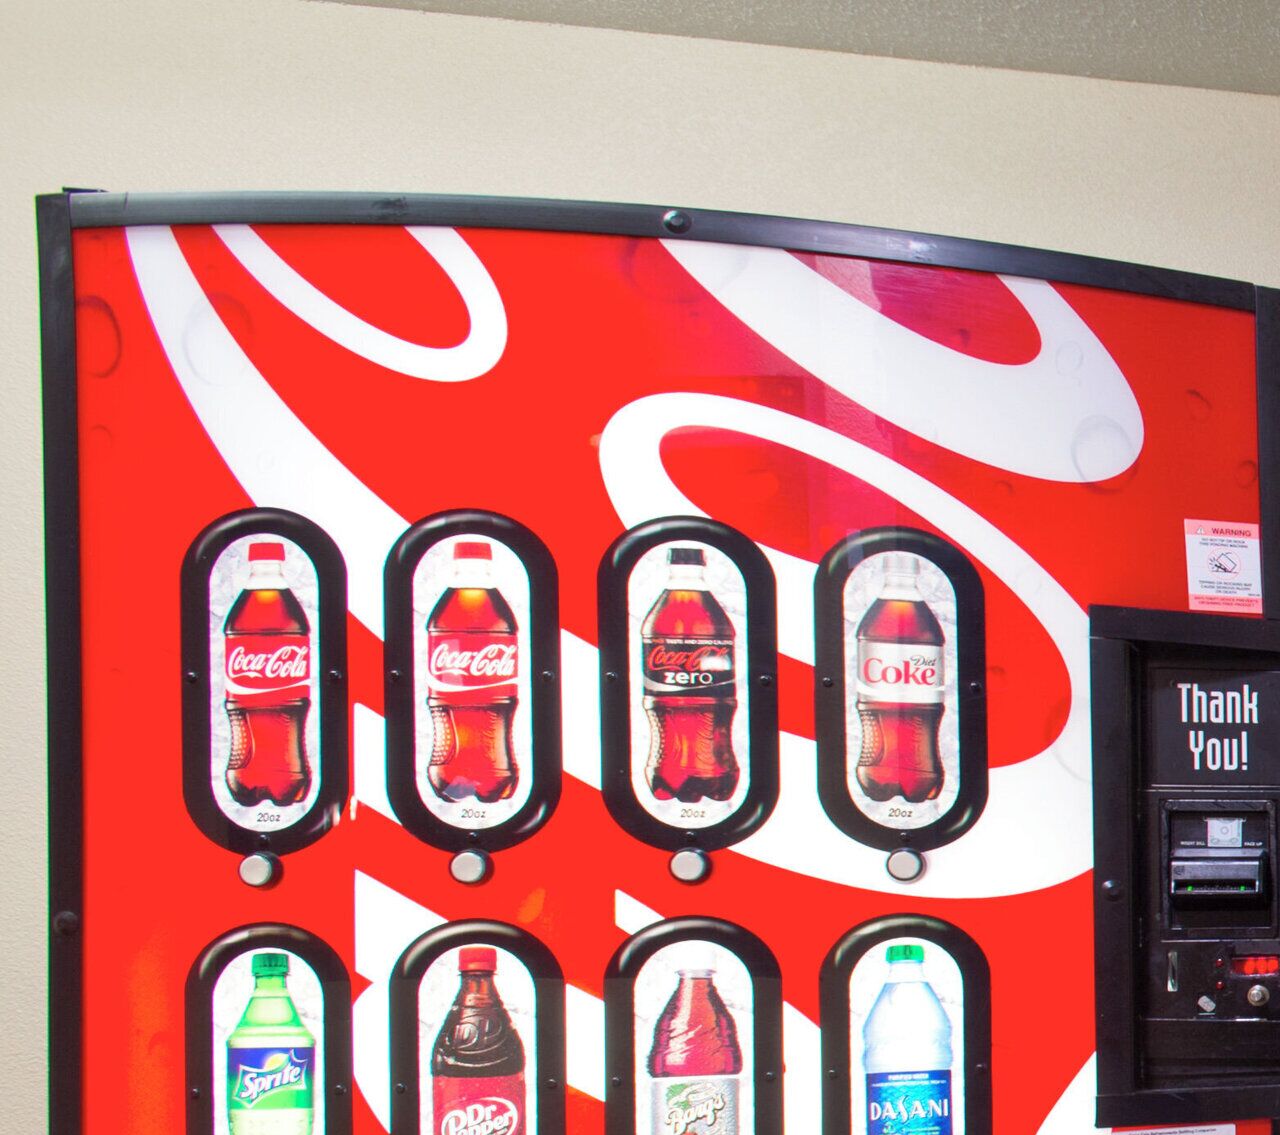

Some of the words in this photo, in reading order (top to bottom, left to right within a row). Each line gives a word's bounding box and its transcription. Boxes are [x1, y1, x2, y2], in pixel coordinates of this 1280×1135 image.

[1210, 527, 1252, 537] WARNING
[228, 645, 309, 679] Coca-Cola
[430, 643, 517, 677] Coca-Cola
[863, 657, 936, 686] Coke
[910, 654, 937, 667] Diet
[664, 671, 714, 685] zero
[1177, 682, 1260, 724] Thank
[1188, 730, 1249, 771] You!
[257, 811, 281, 824] 20oz
[461, 808, 487, 820] 20oz
[680, 808, 706, 819] 20oz
[888, 807, 914, 819] 20oz
[240, 1062, 301, 1101] Sprite
[466, 1103, 498, 1127] Dr
[870, 1095, 949, 1124] DASANI
